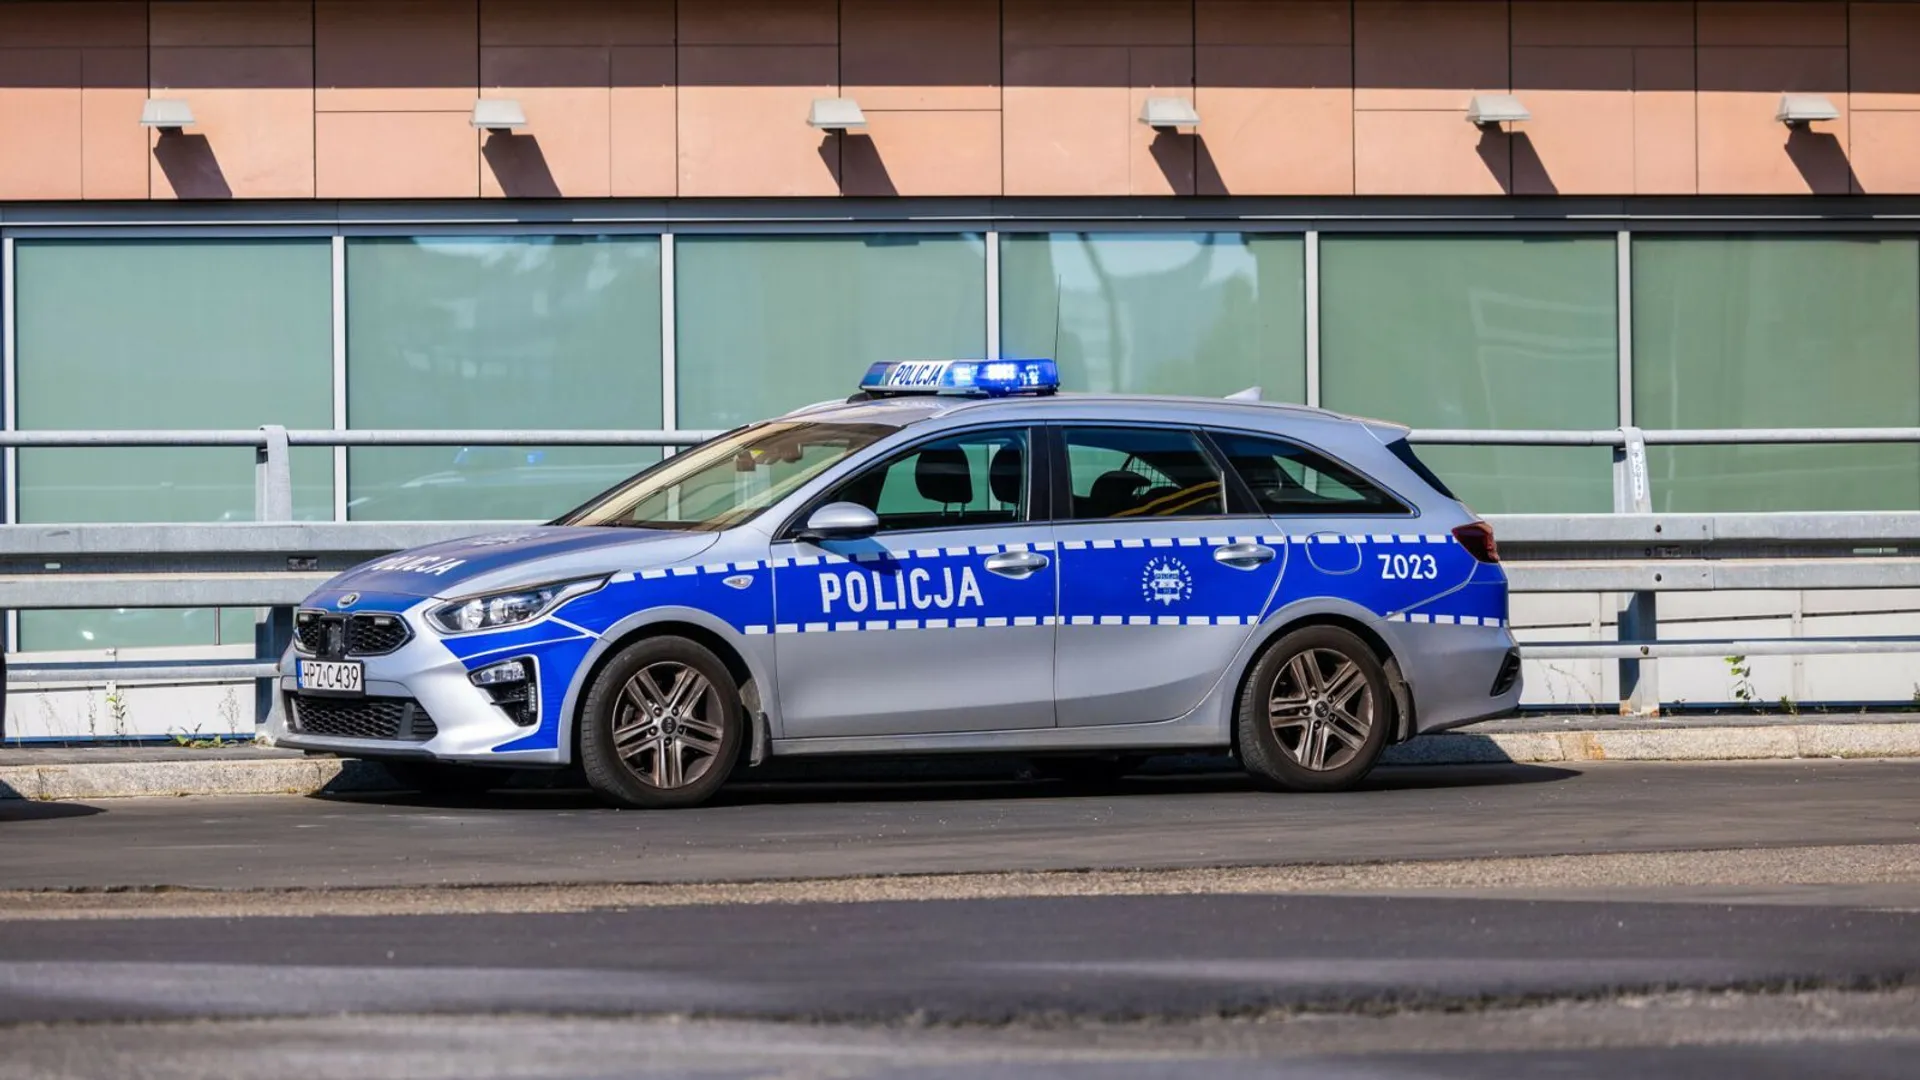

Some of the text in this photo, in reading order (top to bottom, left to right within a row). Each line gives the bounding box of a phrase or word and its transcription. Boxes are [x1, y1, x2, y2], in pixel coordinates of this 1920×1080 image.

[890, 364, 944, 387] POLICJA
[1377, 554, 1438, 579] Z023
[818, 566, 984, 613] POLICJA
[302, 662, 359, 689] HPZ C439
